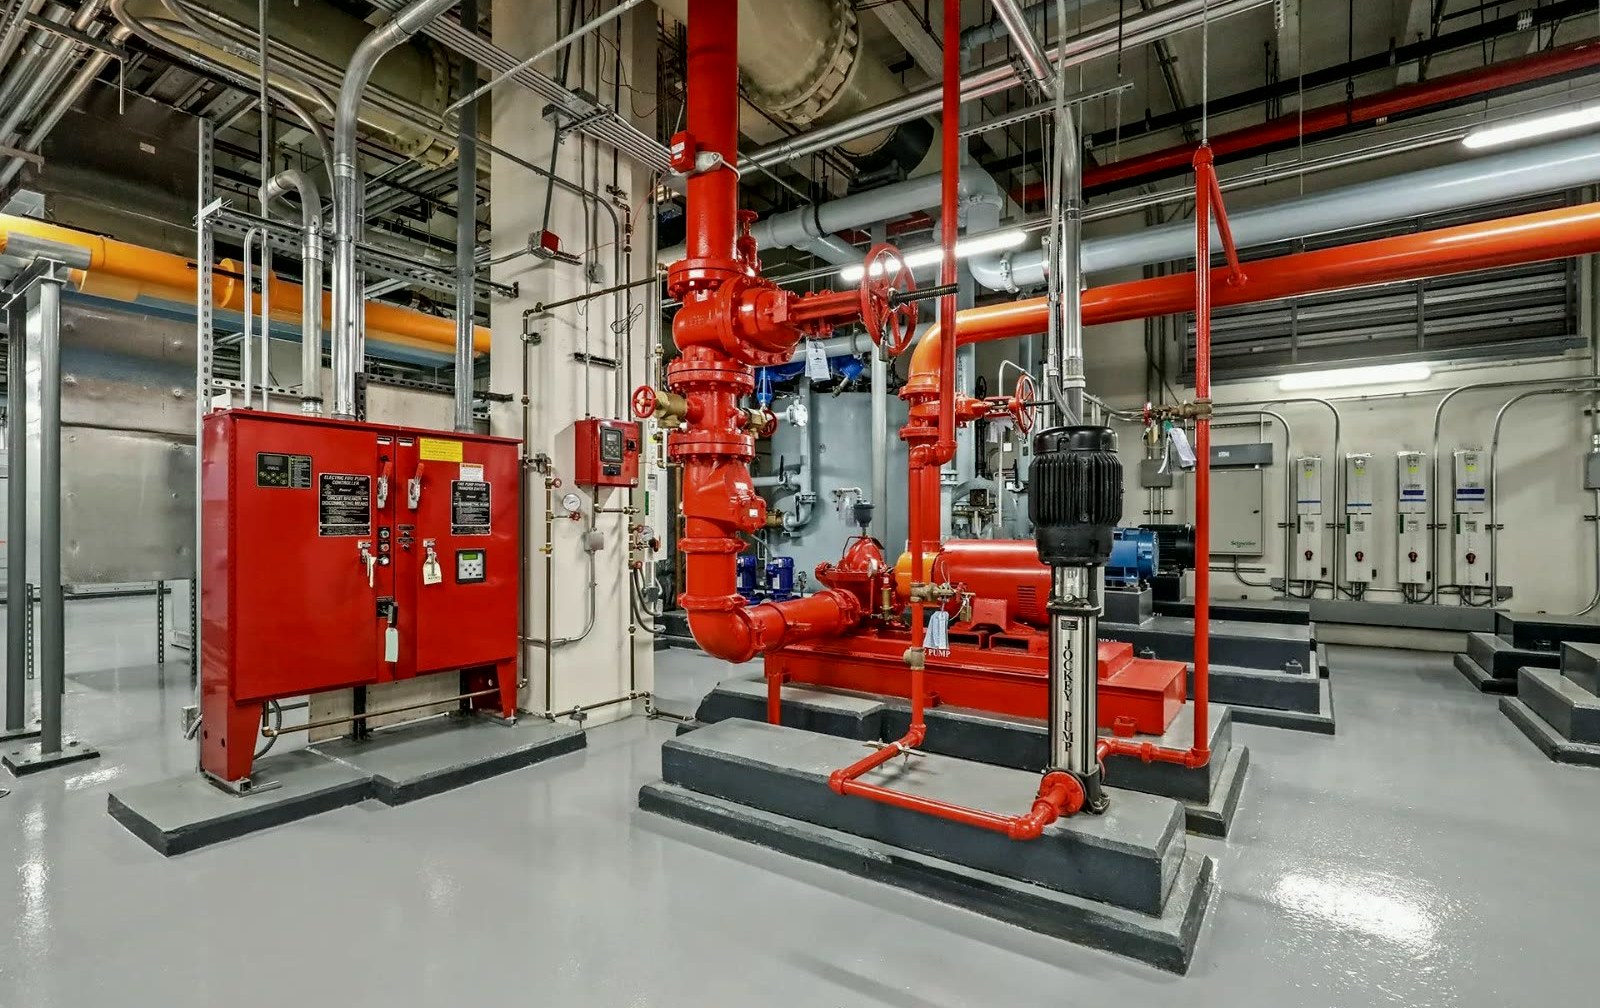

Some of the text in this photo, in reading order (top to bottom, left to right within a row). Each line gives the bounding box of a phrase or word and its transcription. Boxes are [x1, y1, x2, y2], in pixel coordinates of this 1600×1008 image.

[928, 648, 951, 657] PUMP
[1063, 639, 1073, 701] JOCKEY
[1063, 711, 1073, 752] PUMP
